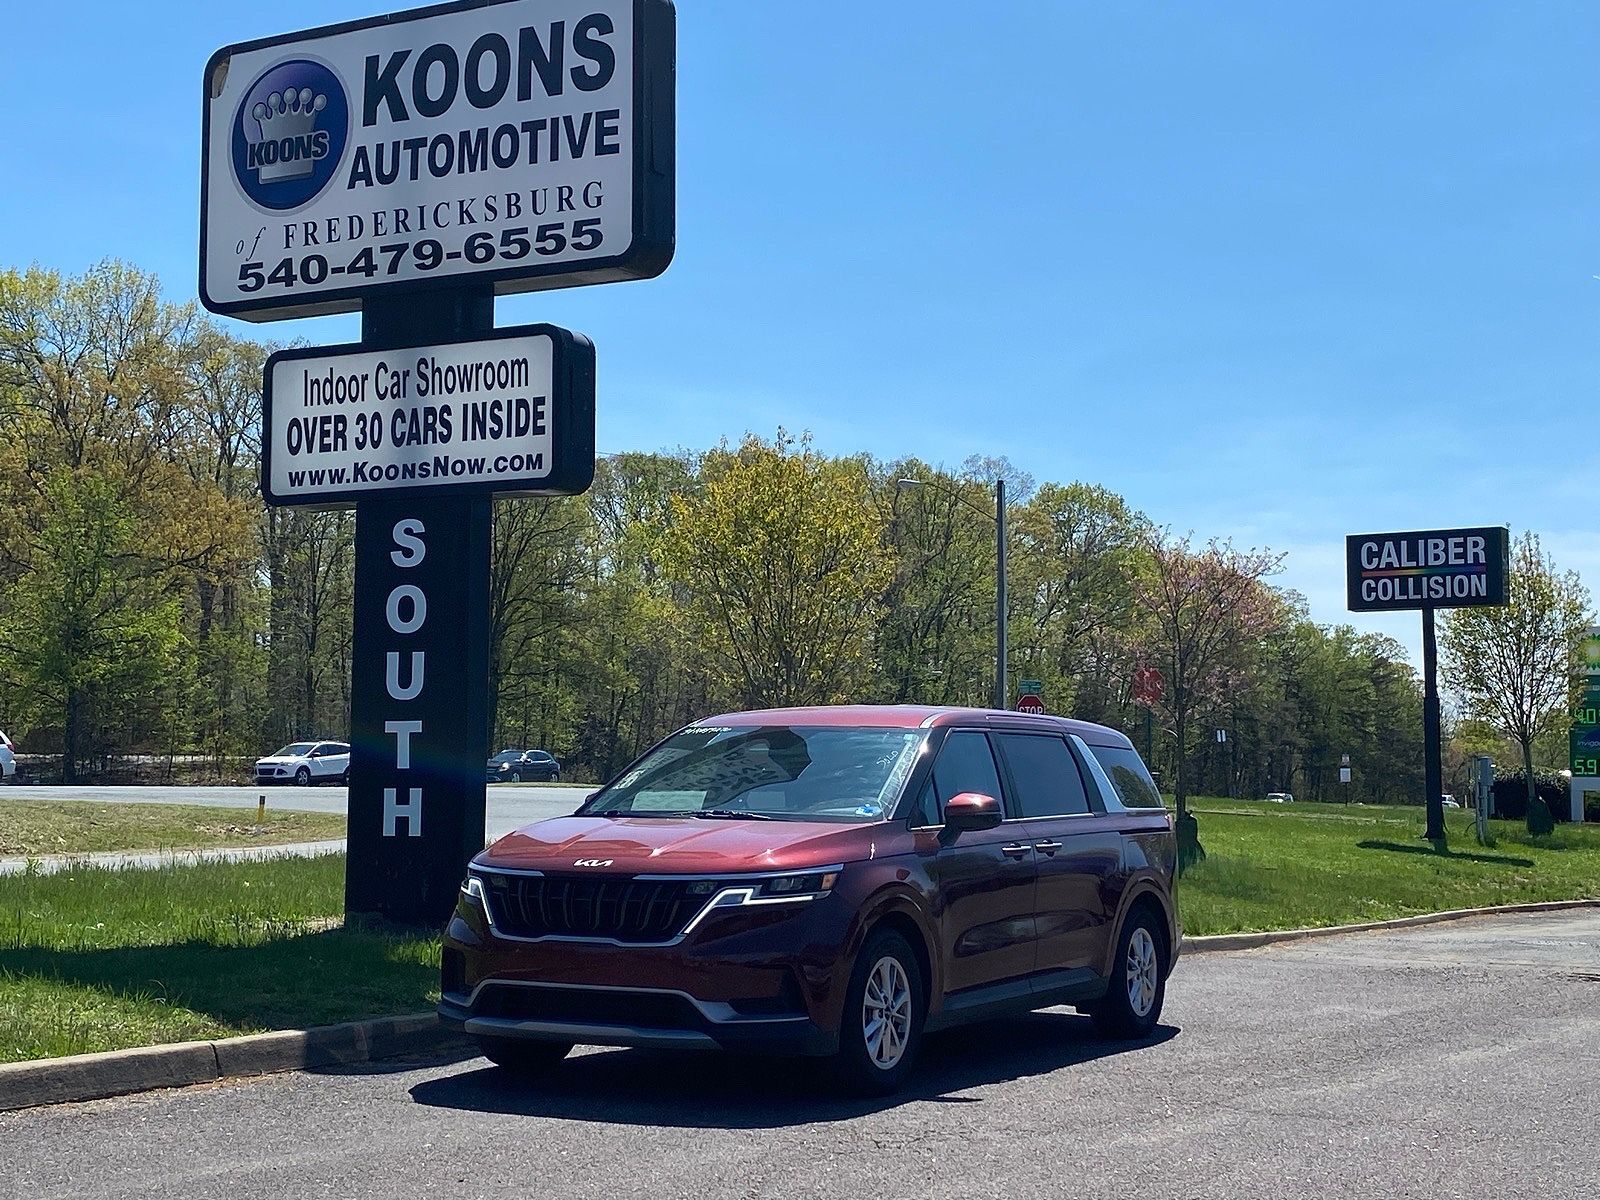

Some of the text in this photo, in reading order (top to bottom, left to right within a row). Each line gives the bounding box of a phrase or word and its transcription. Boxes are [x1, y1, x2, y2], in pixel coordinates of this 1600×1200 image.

[362, 12, 616, 128] KOONS
[247, 130, 330, 169] KOONS
[346, 108, 620, 190] AUTOMOTIVE
[235, 180, 604, 262] of FREDERICKSBURG
[237, 217, 604, 293] 540-479-6555
[303, 357, 529, 407] Indoor Car Showroom
[286, 395, 546, 456] OVER 30 CARS INSIDE
[1360, 536, 1486, 570] CALIBER
[1361, 573, 1487, 602] COLLISION
[382, 518, 427, 837] SOUTH
[573, 858, 614, 867] KIA
